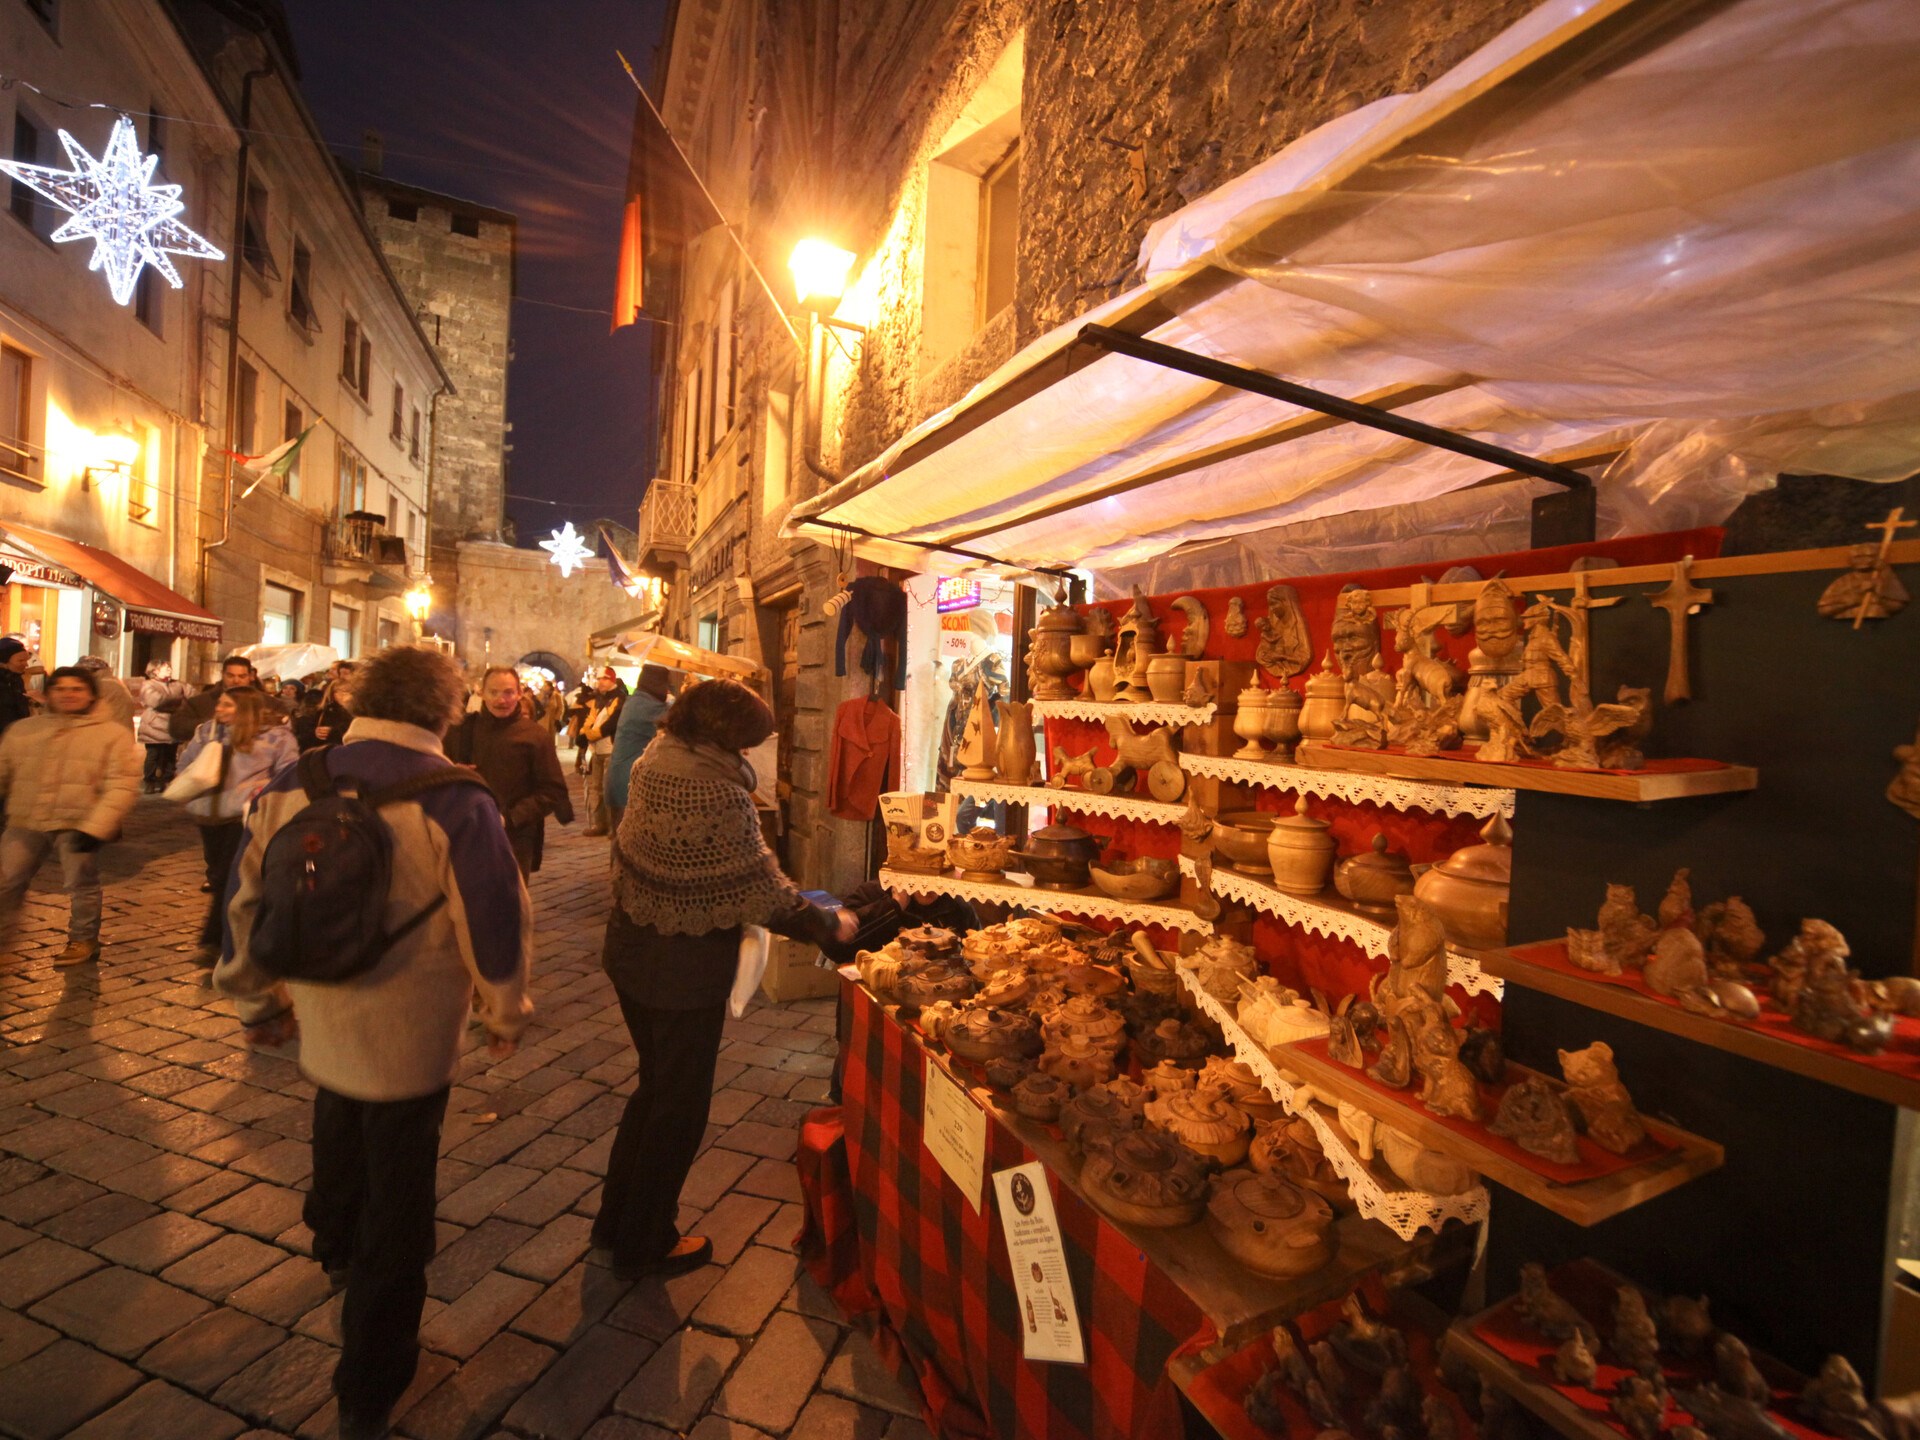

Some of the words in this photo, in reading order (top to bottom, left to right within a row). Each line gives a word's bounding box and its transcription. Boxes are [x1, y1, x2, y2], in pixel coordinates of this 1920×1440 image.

[129, 613, 175, 633] FROMAGERIE
[178, 621, 219, 639] CHARCUTERIE
[941, 613, 970, 631] SCONTI
[950, 637, 967, 649] 50%
